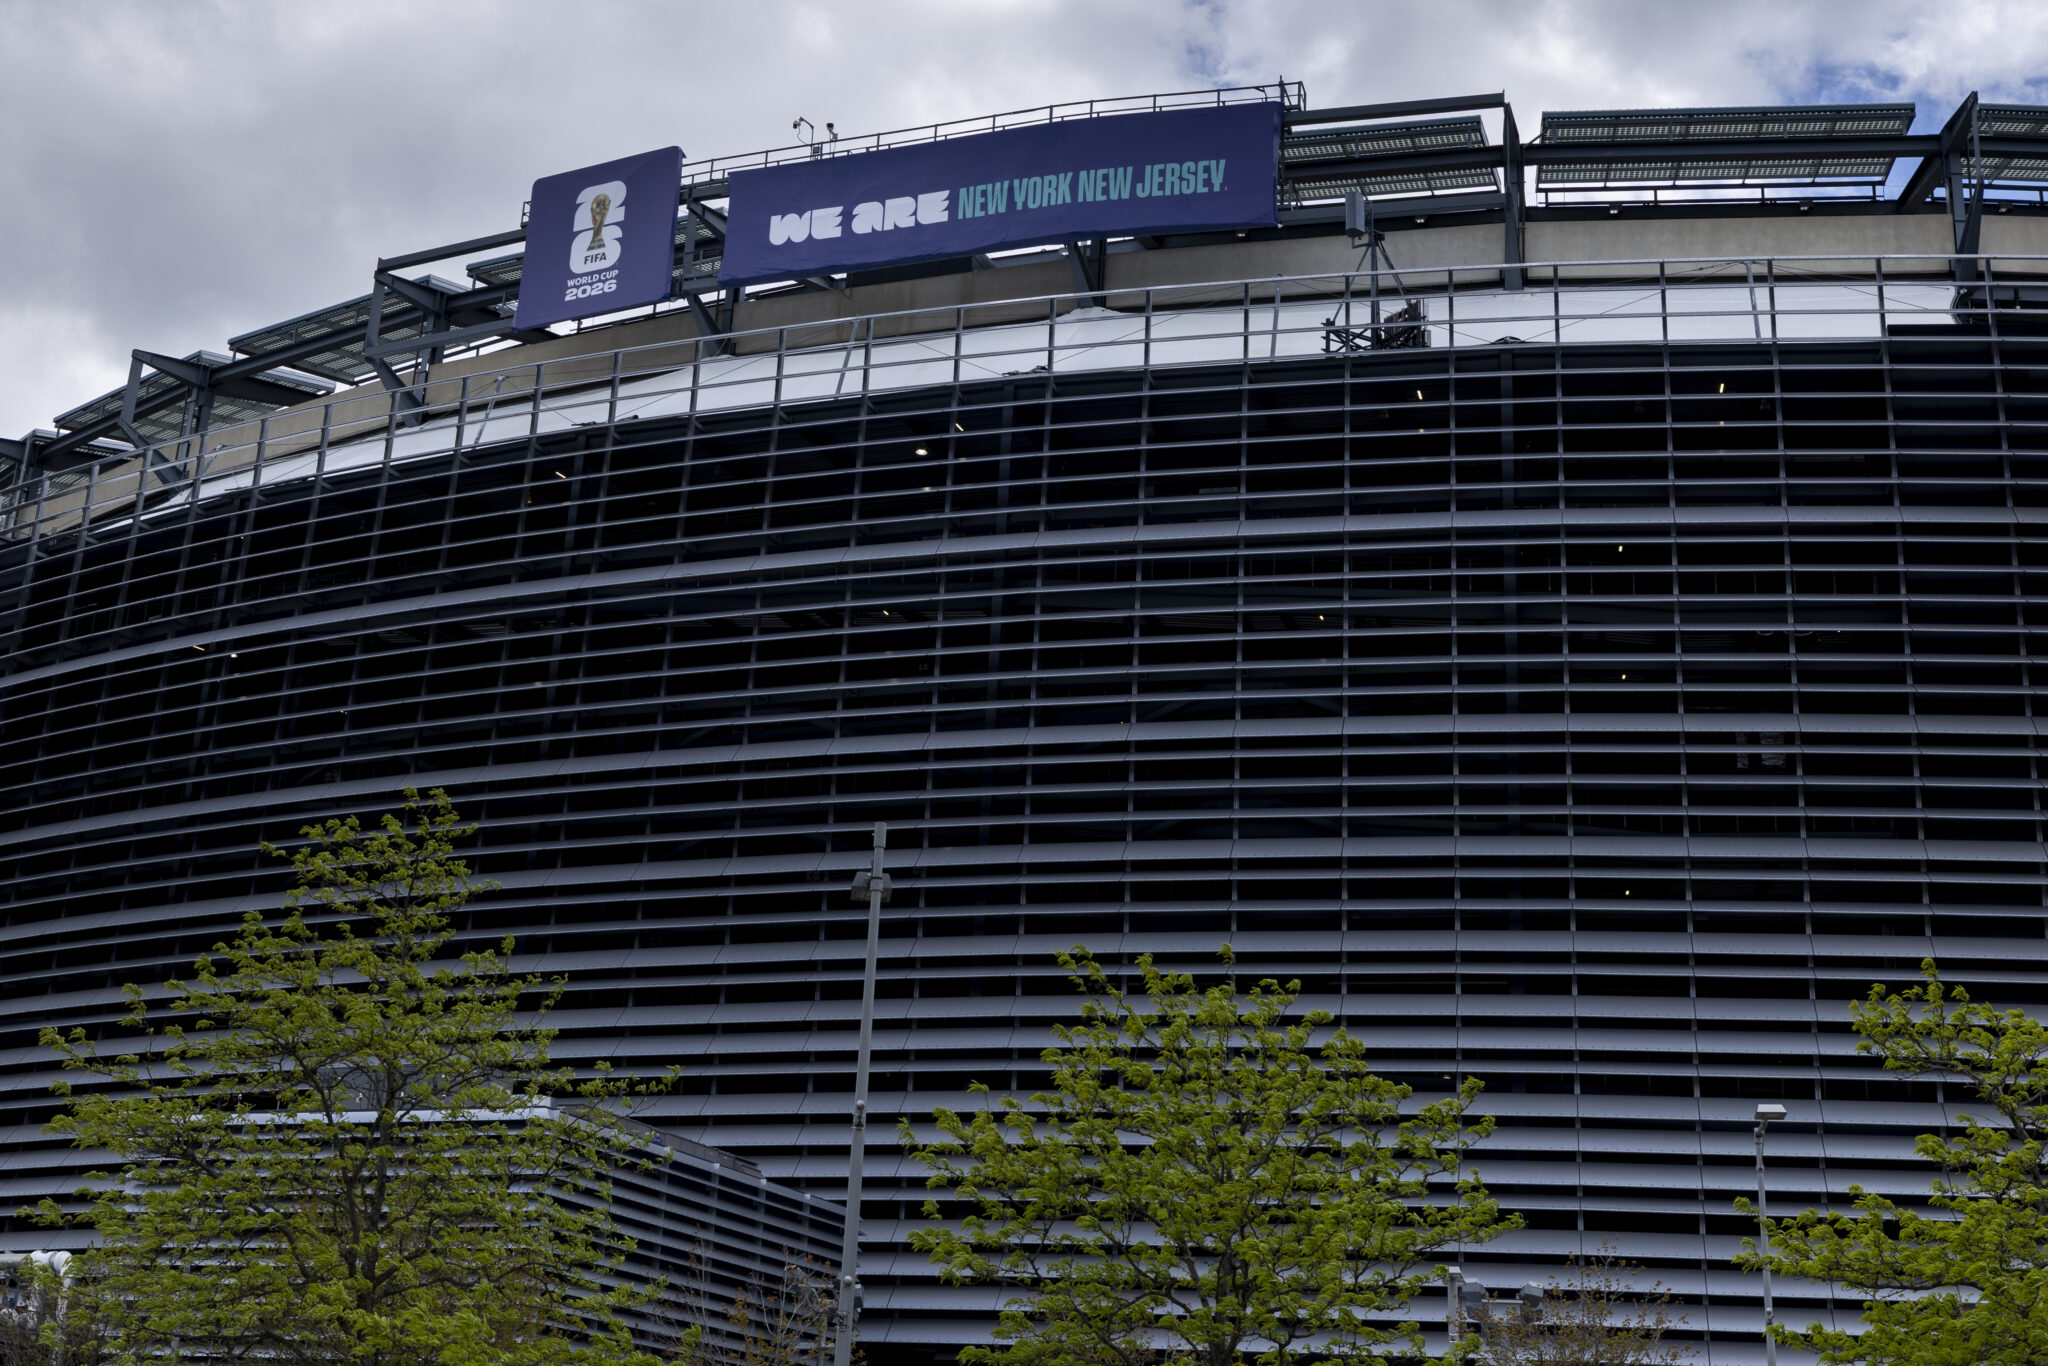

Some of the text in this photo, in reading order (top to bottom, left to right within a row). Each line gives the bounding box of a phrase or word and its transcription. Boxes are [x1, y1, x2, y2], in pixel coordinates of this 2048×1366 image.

[769, 206, 844, 246] WE
[957, 180, 1009, 220] NEW
[1013, 172, 1073, 211] YORK
[1077, 166, 1133, 203] NEW
[1136, 159, 1226, 198] JERSEY
[583, 251, 607, 265] FIFA
[567, 269, 619, 288] WORLD CUP
[565, 279, 617, 301] 2026
